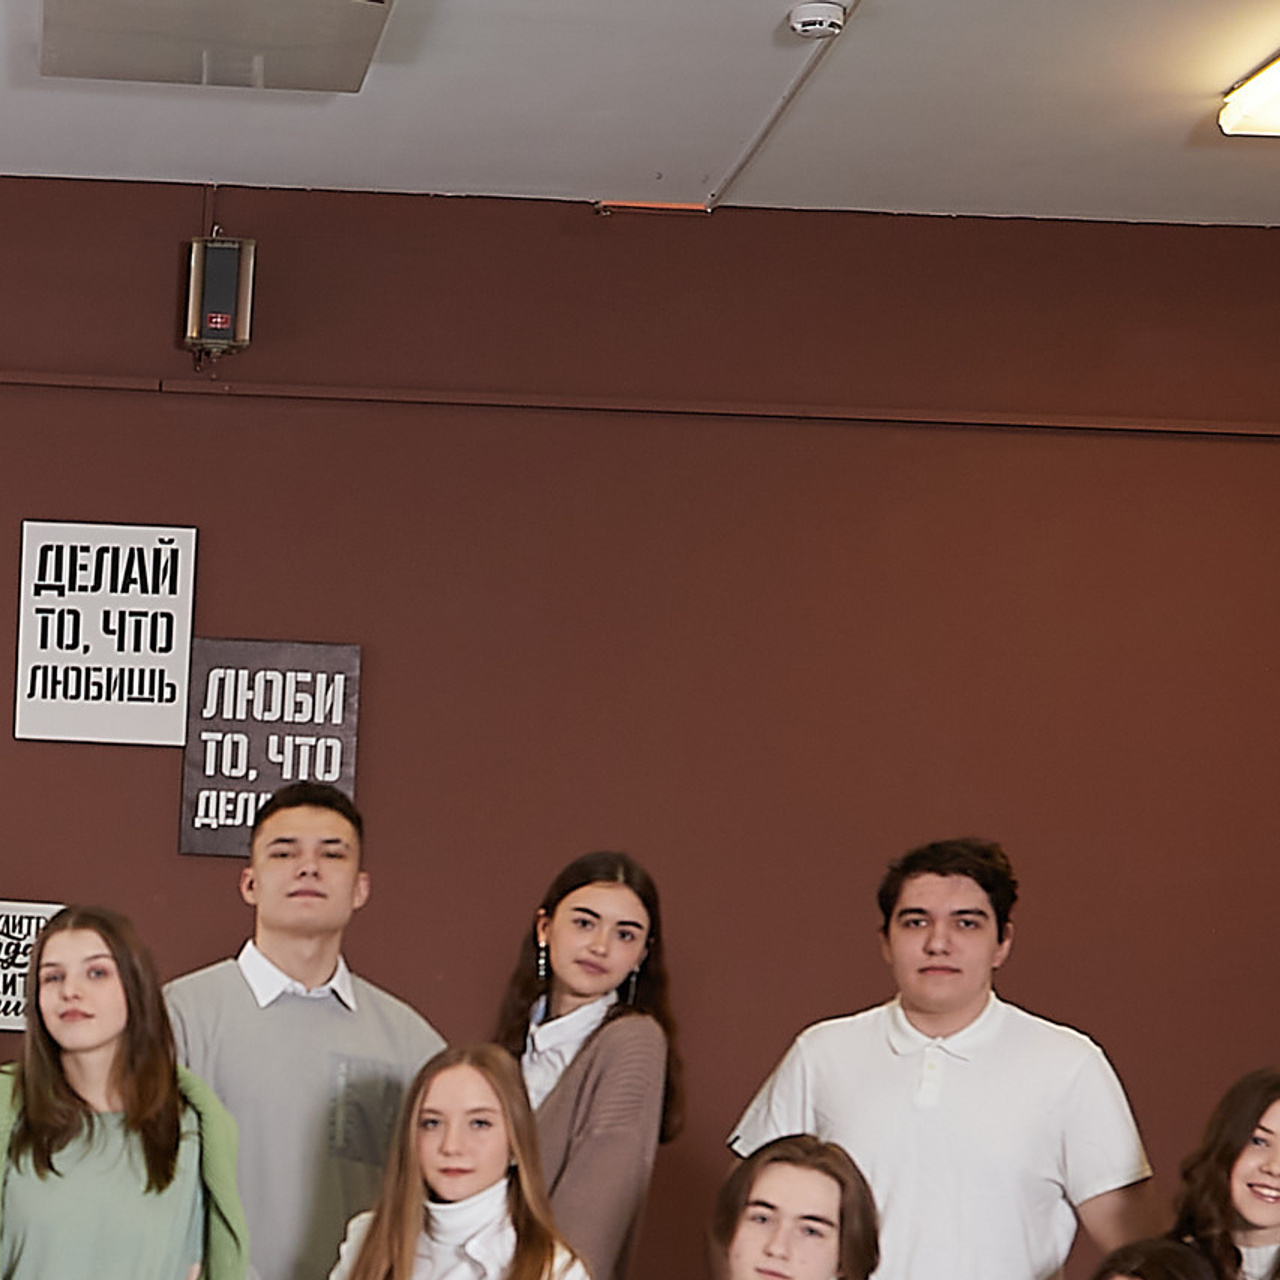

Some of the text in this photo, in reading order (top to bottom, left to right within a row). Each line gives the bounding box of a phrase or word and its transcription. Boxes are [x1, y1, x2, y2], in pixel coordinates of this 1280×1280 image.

[33, 537, 180, 597] ДЕЛАЙ
[34, 607, 175, 656] ТО, ЧТО
[26, 664, 178, 704] ЛЮБИШЬ
[201, 667, 347, 725] ЛЮБИ
[200, 731, 343, 783] ТО, ЧТО
